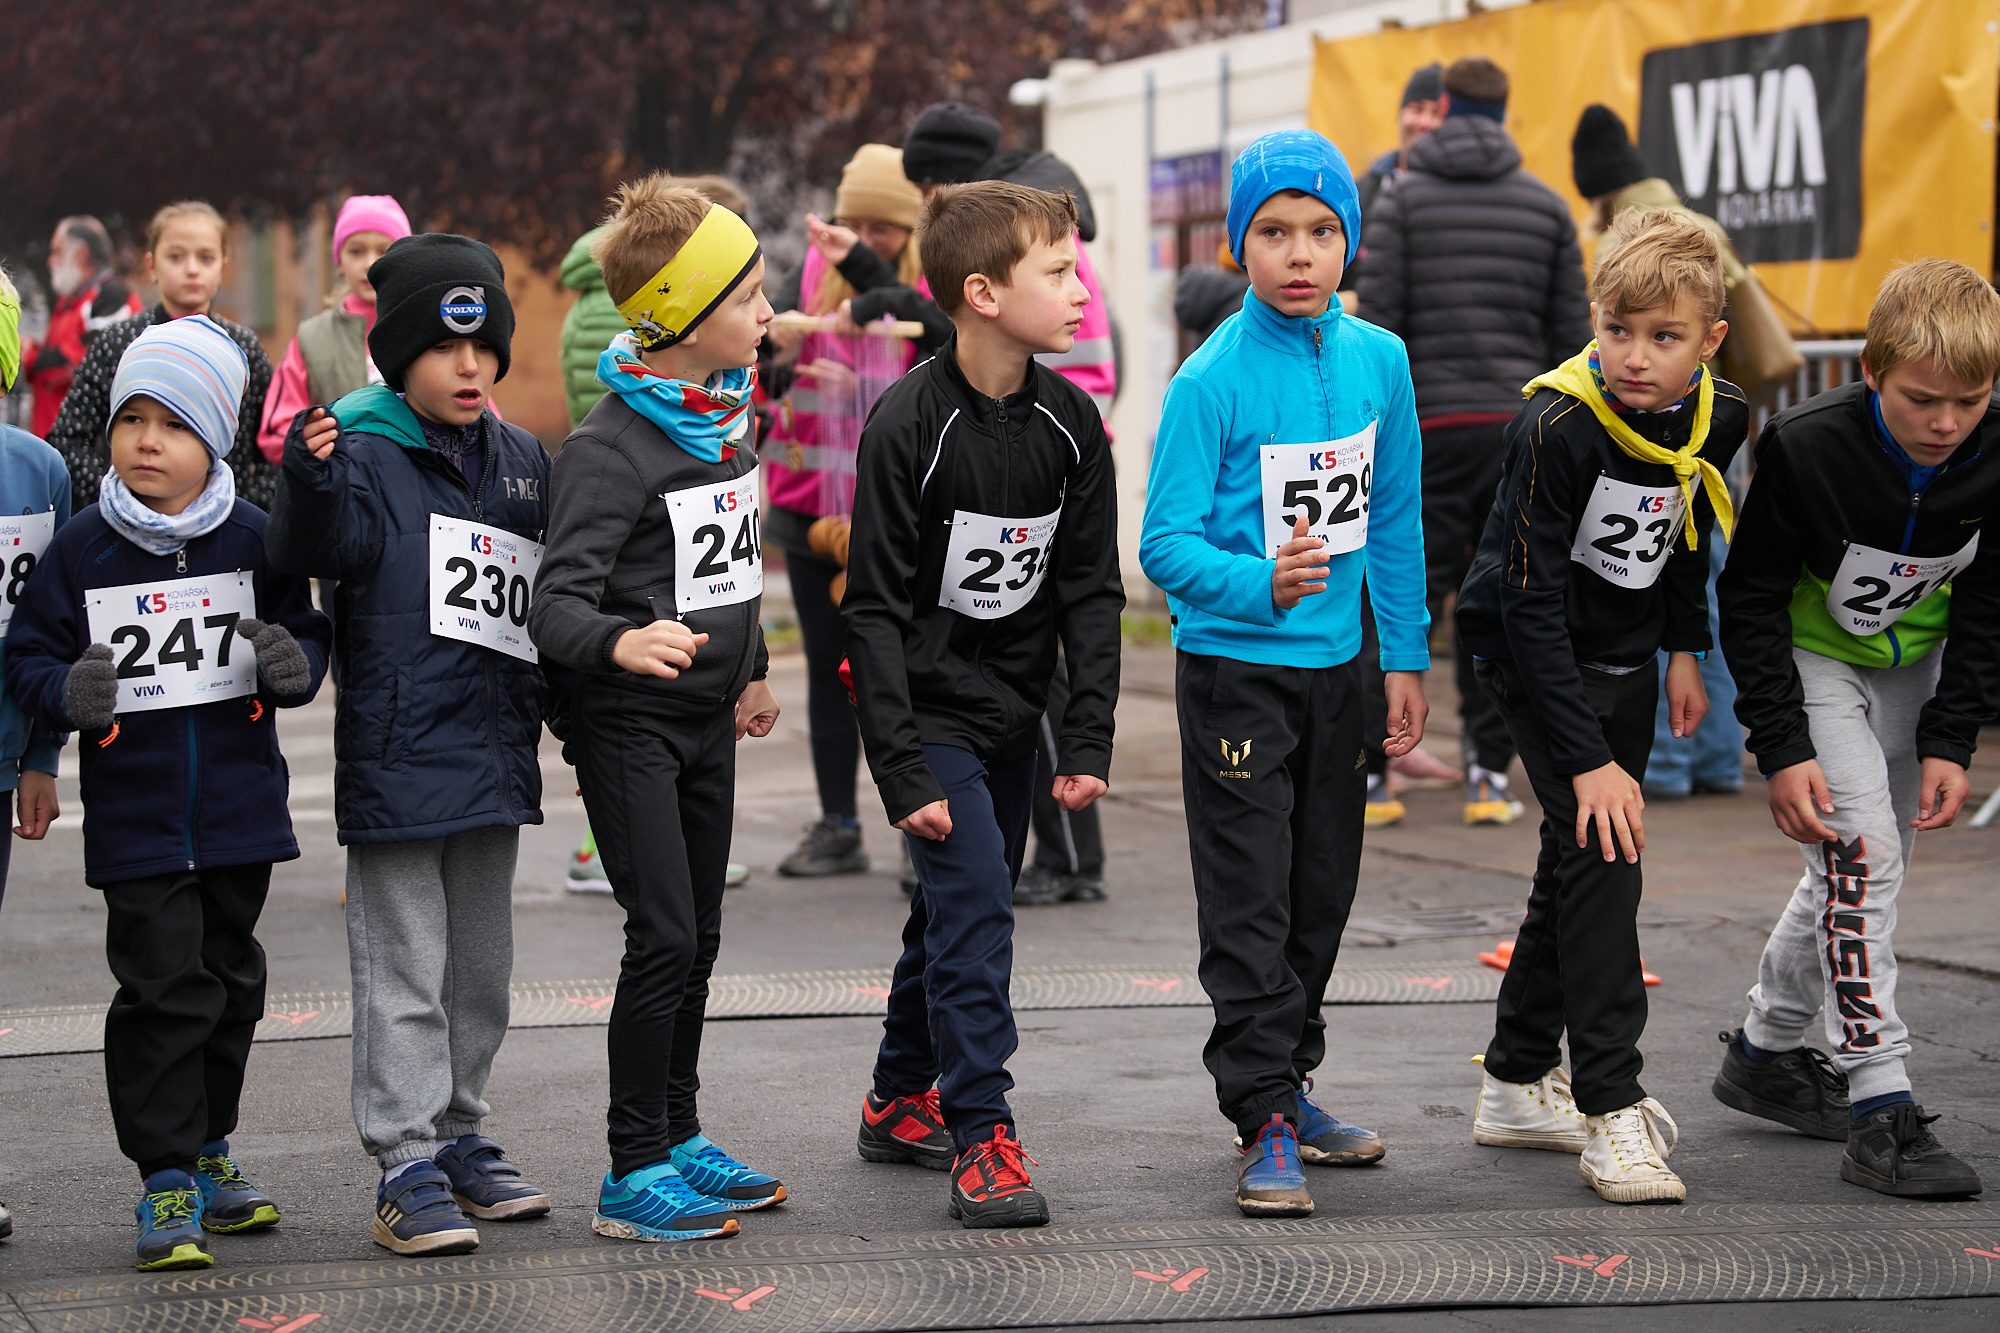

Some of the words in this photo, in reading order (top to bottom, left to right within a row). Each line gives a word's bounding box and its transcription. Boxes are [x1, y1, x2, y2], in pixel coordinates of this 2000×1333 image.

[443, 306, 483, 314] VOLVO
[1309, 450, 1337, 471] K5
[713, 491, 738, 514] K5
[1281, 462, 1371, 528] 529
[1637, 495, 1665, 513] K5
[471, 532, 492, 555] K5
[999, 527, 1029, 544] K5
[0, 552, 37, 606] 8
[1888, 561, 1920, 577] K5
[444, 556, 529, 628] 230
[136, 593, 168, 615] K5
[110, 612, 241, 679] 247
[1219, 770, 1251, 779] MESSI
